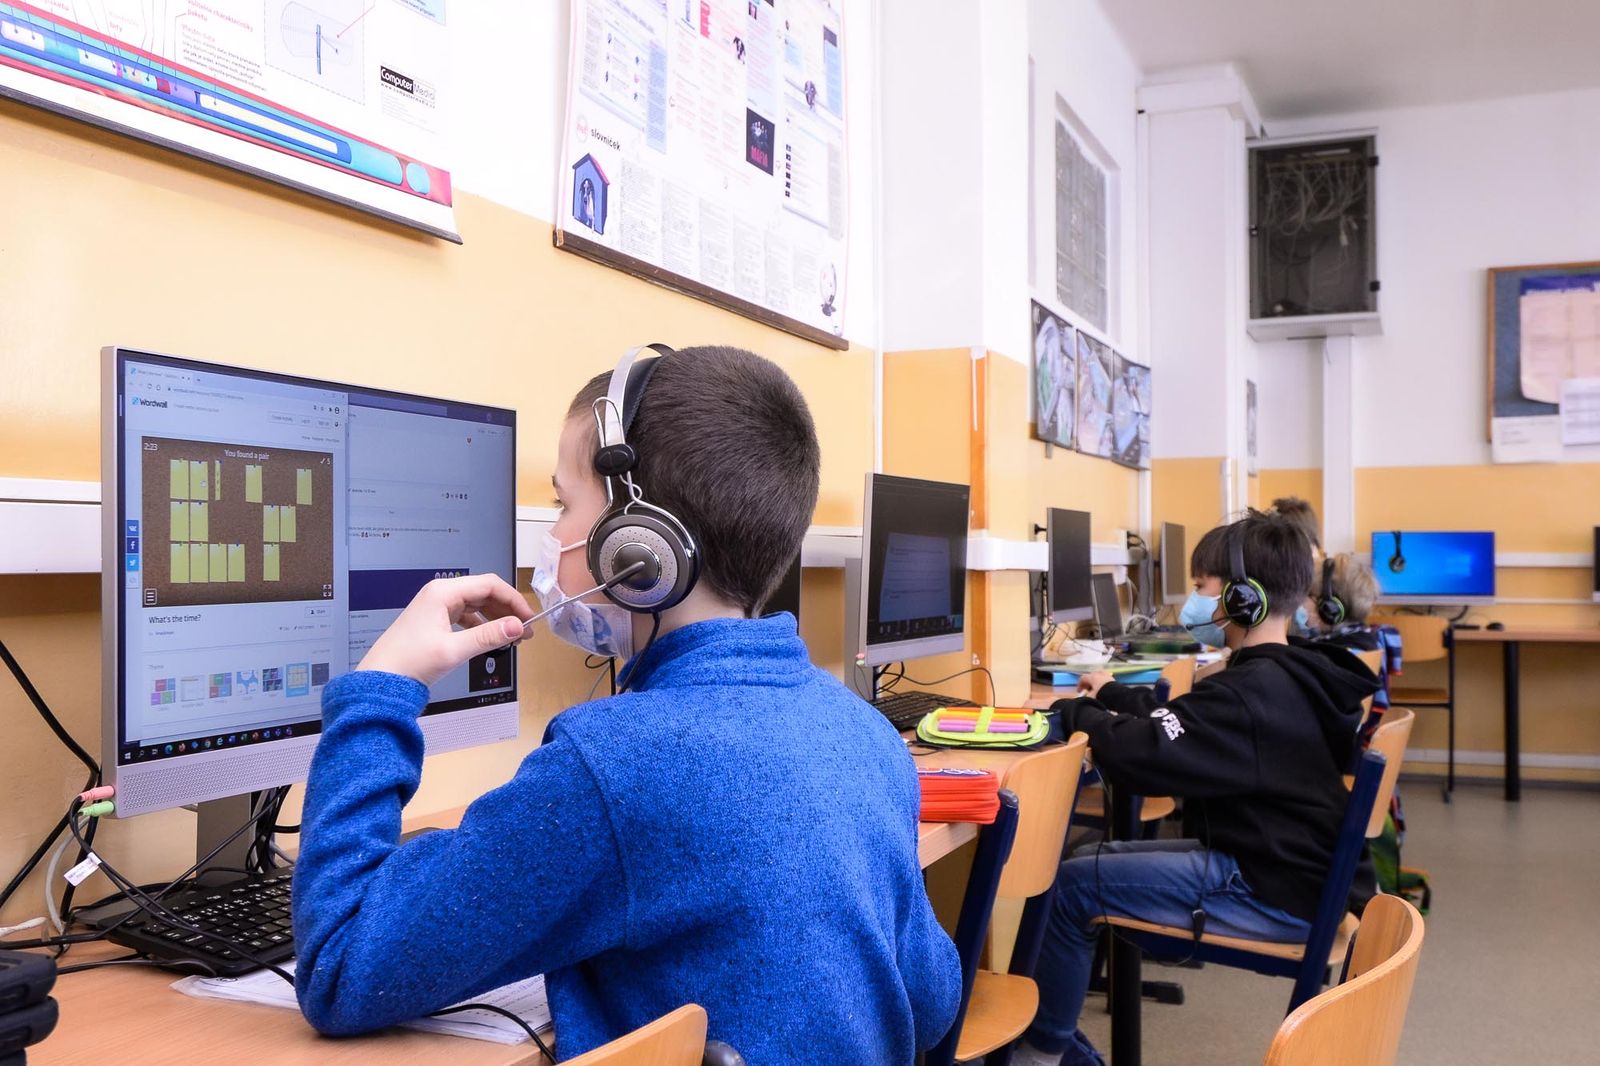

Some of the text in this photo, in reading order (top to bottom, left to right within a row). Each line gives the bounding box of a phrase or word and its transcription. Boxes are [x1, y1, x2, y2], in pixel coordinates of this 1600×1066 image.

[381, 68, 413, 90] Computer
[140, 398, 168, 409] Wordwall
[223, 449, 236, 458] You
[236, 451, 254, 460] found
[258, 453, 270, 461] pair
[148, 614, 202, 624] What's the time?
